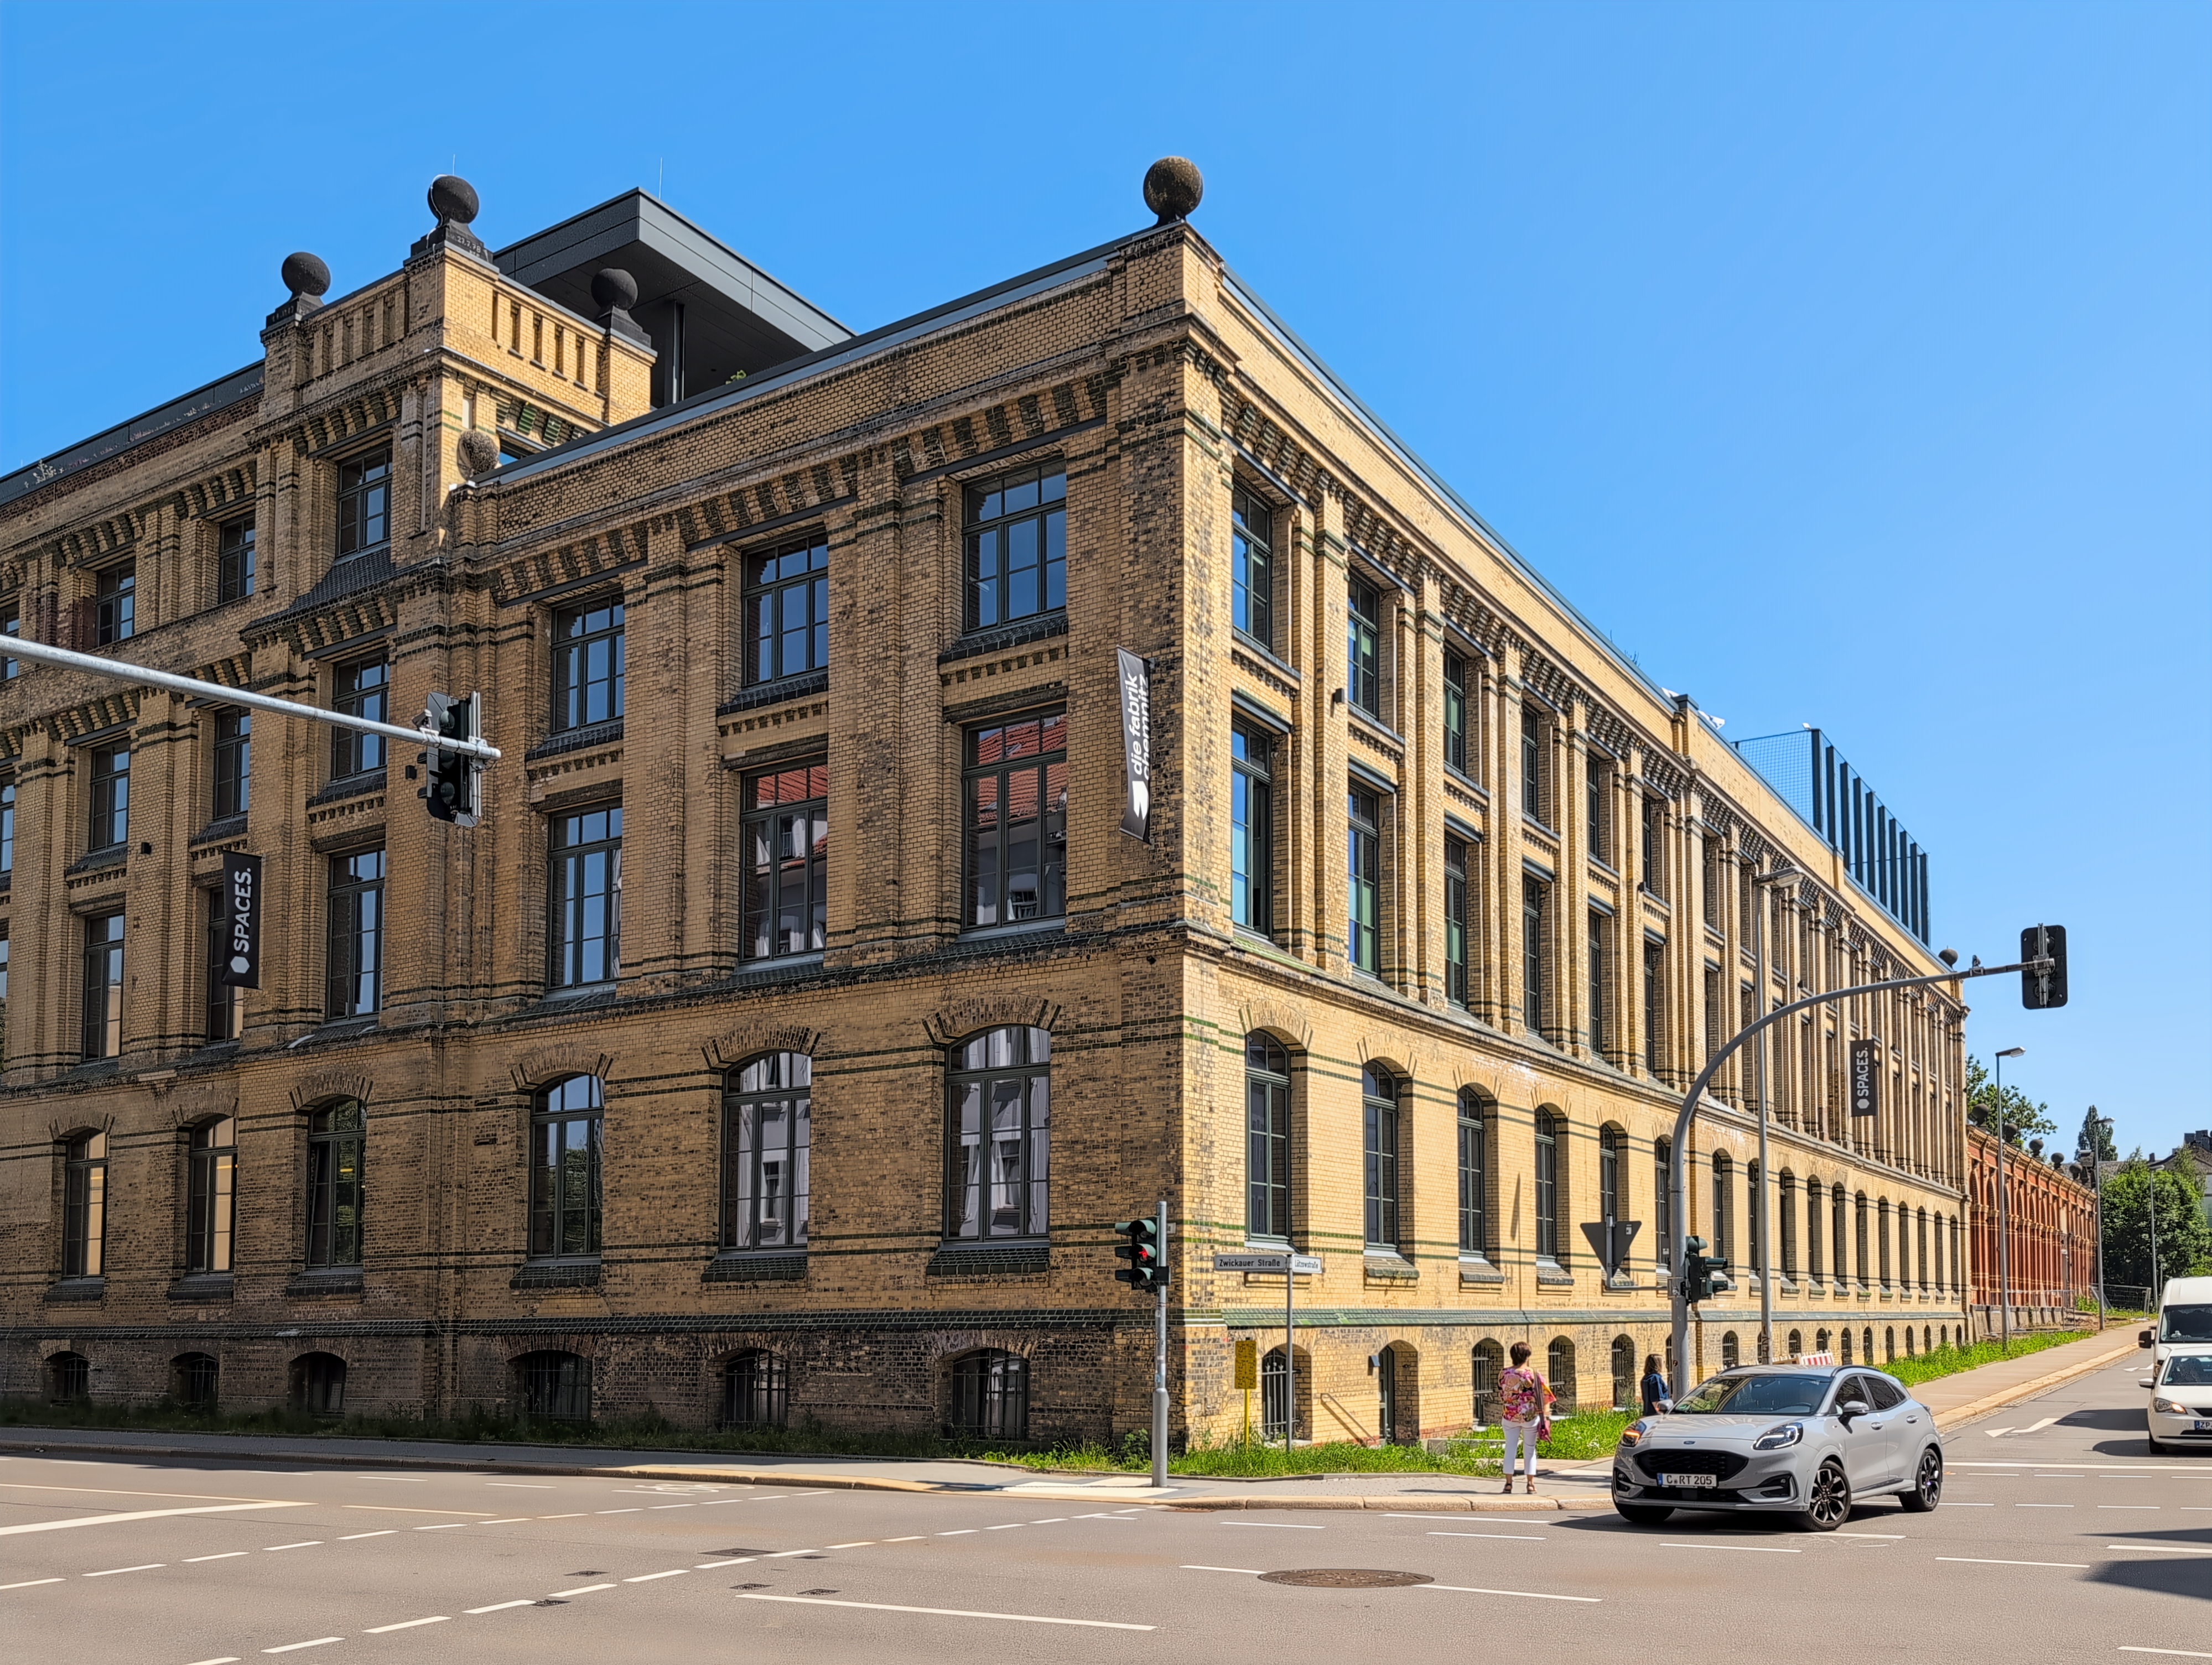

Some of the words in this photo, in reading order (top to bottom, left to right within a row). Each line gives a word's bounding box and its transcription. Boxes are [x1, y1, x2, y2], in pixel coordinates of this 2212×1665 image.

[1124, 672, 1141, 737] fabrik
[1138, 673, 1150, 781] chemnitz
[1130, 740, 1143, 776] die
[233, 867, 252, 953] SPACES.
[1856, 1047, 1869, 1097] SPACES.
[1219, 1259, 1254, 1267] Zwickauer
[1258, 1259, 1280, 1267] Straße
[1666, 1475, 1673, 1484] C
[1679, 1475, 1691, 1485] RT
[1694, 1476, 1712, 1485] 205
